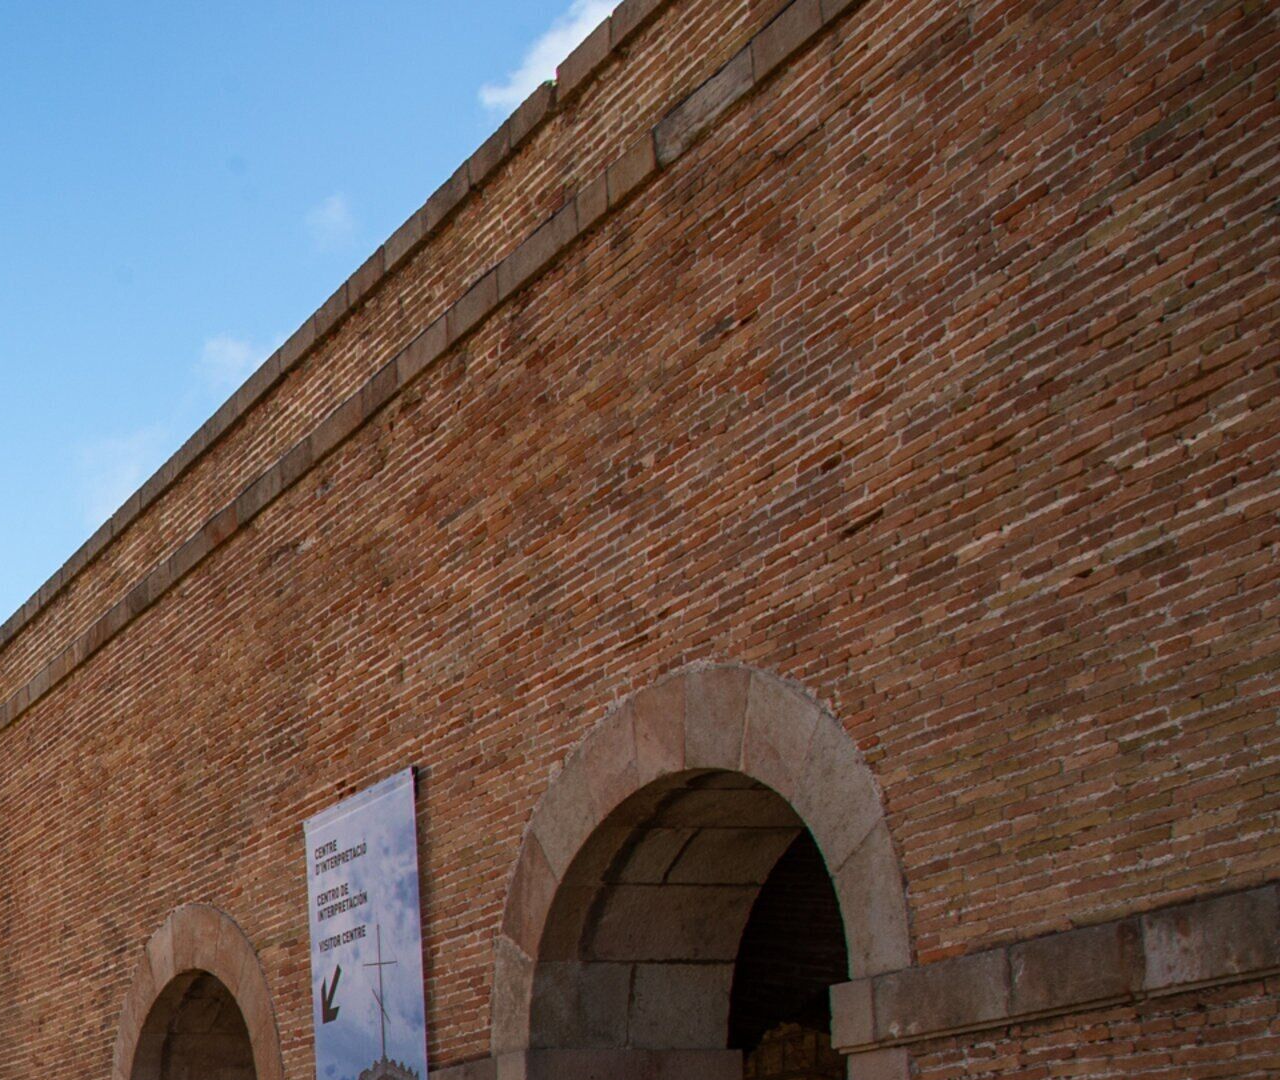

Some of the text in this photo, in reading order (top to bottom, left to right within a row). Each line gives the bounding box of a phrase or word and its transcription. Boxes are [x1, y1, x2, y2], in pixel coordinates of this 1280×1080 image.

[315, 839, 337, 860] CENTRE
[315, 838, 367, 876] D'INTERPRETACIÓ
[317, 882, 349, 906] CENTRO DE
[317, 888, 368, 922] INTERPRETACIÓN
[319, 925, 366, 953] VISITOR CENTRE
